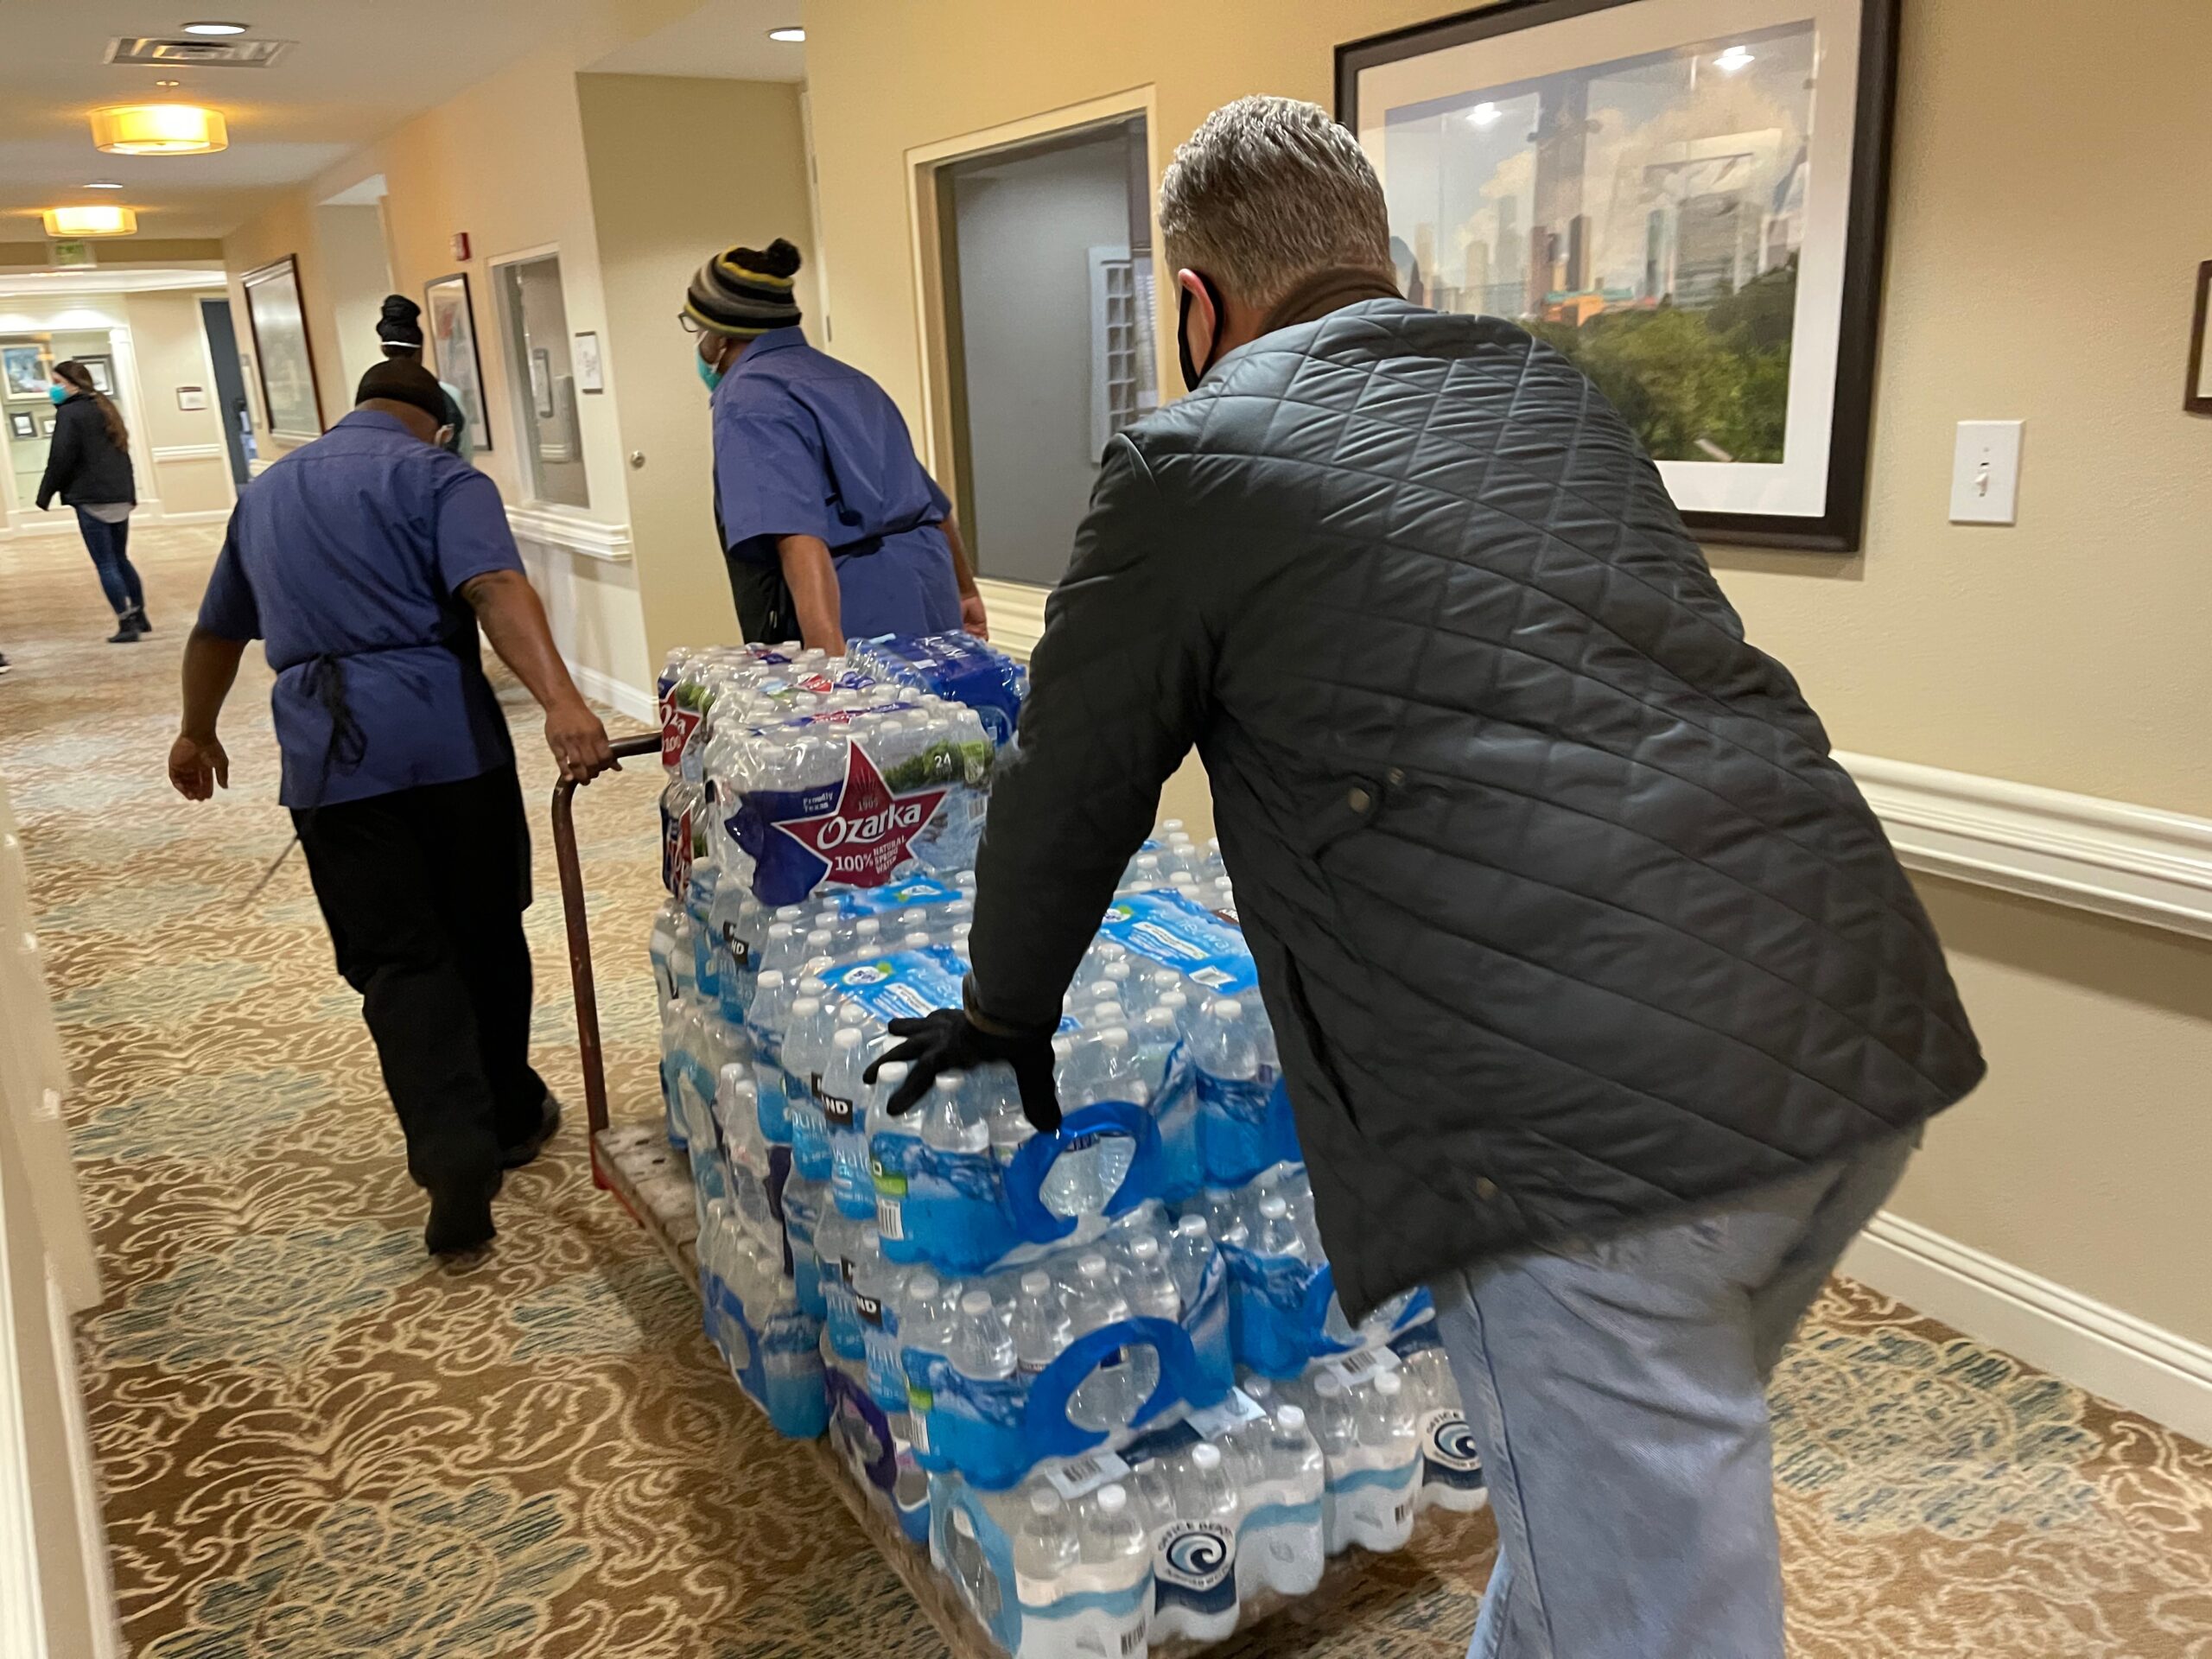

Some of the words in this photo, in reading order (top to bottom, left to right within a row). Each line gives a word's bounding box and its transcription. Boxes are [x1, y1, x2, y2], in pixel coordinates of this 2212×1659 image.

[817, 804, 922, 849] Ozarka
[874, 835, 906, 855] NATURAL
[835, 853, 874, 872] 100%
[874, 849, 899, 864] SPRING
[875, 856, 897, 874] WATER
